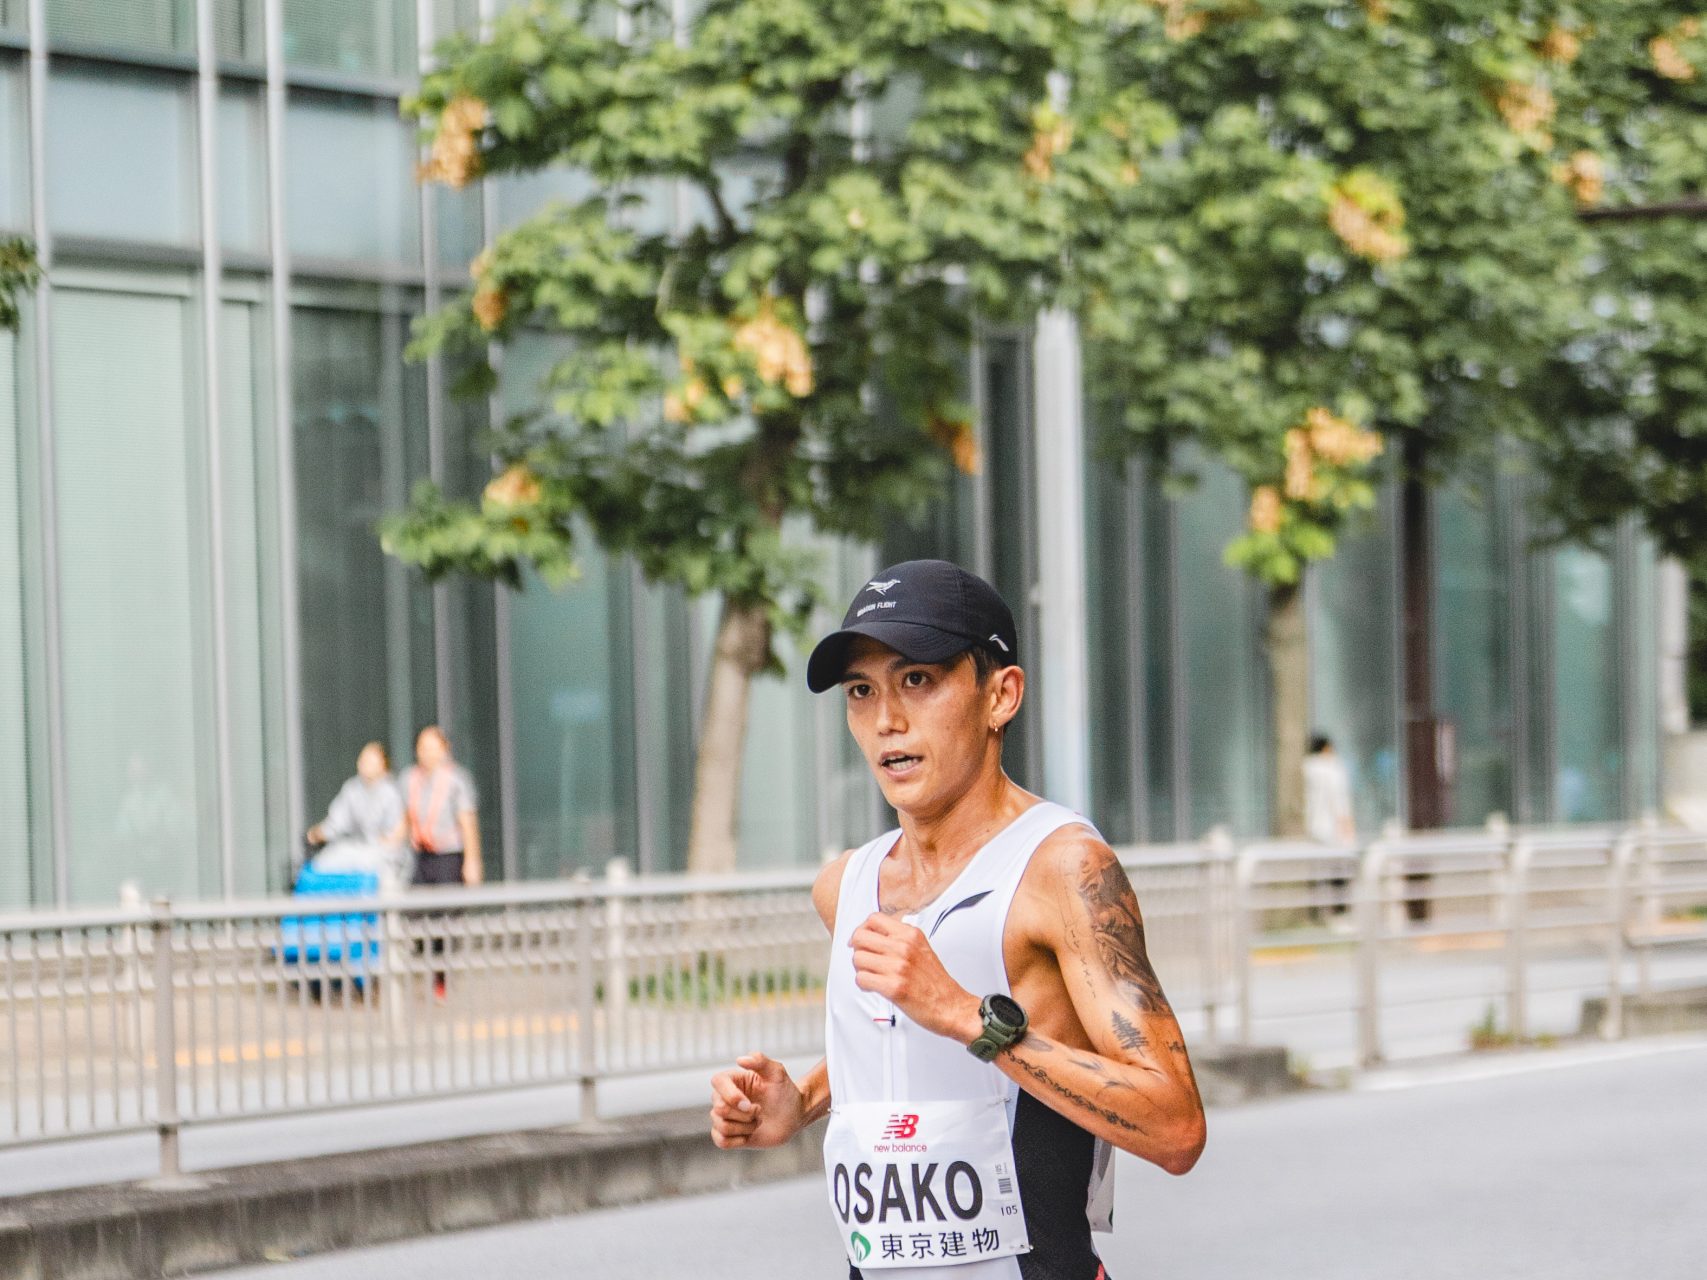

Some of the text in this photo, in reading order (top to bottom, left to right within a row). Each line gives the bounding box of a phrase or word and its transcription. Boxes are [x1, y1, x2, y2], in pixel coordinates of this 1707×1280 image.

[874, 1143, 927, 1152] new balance
[834, 1160, 983, 1224] OSAKO
[1001, 1205, 1018, 1216] 105
[880, 1228, 1000, 1260] 東京建物
